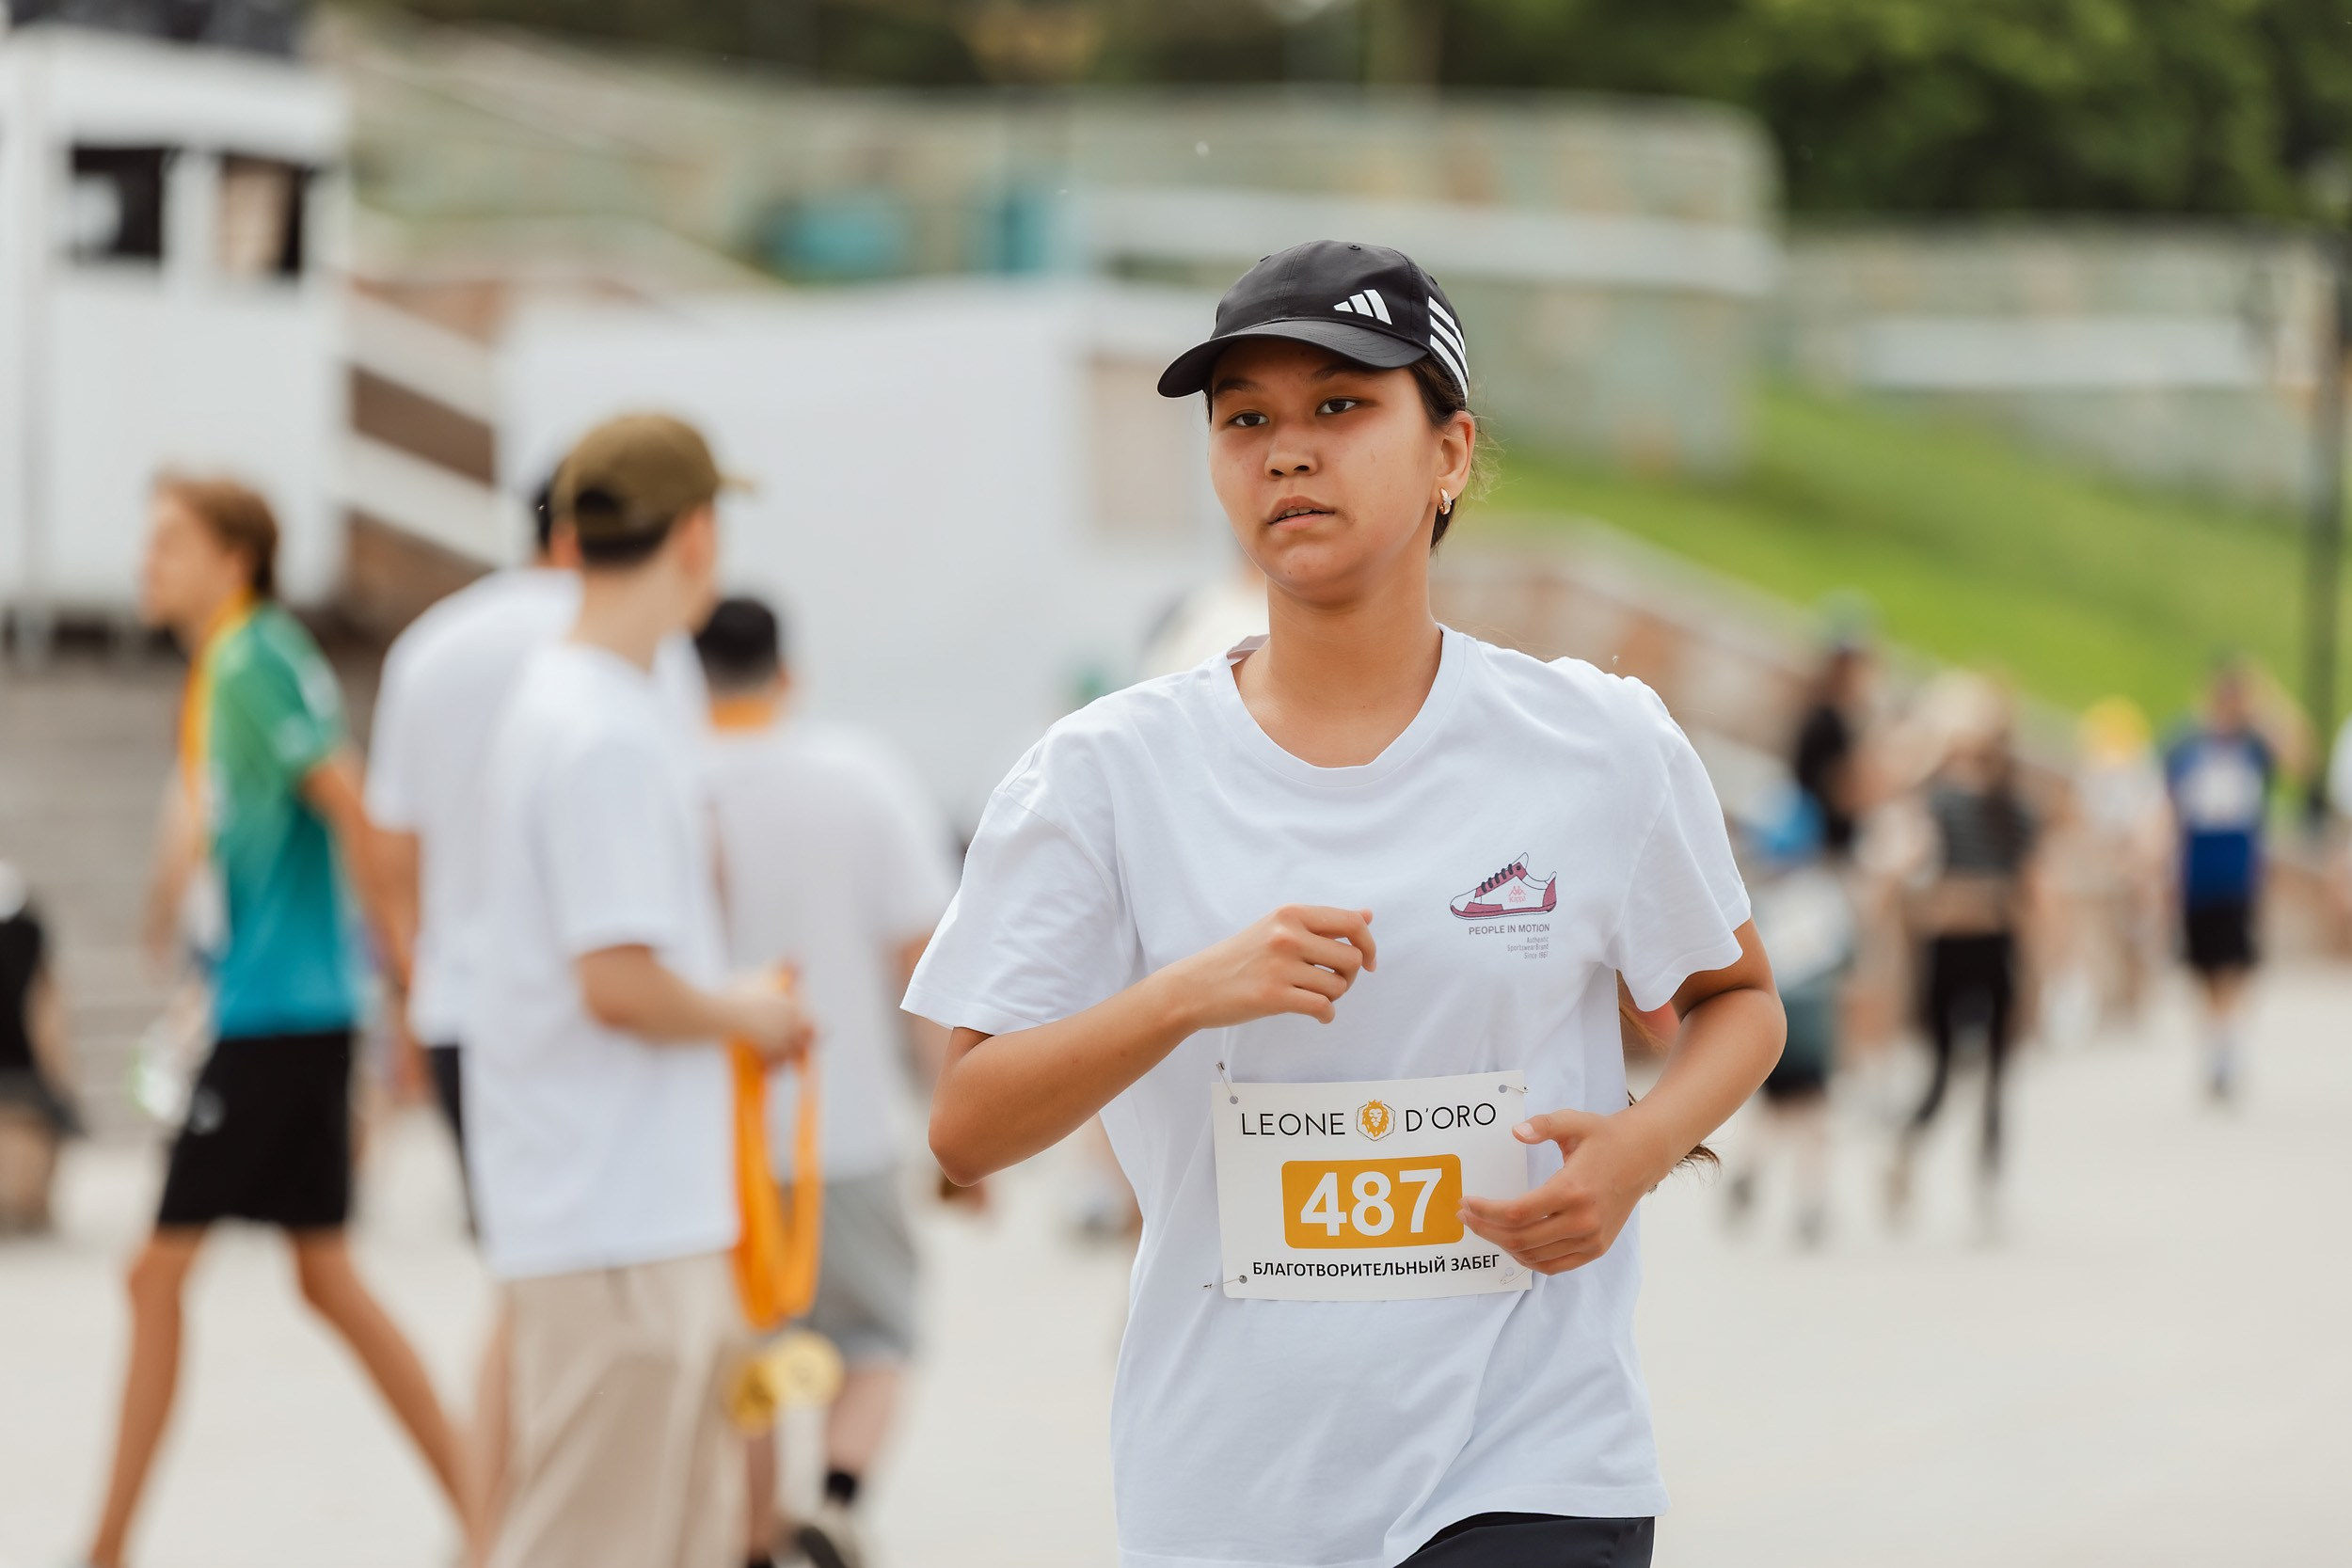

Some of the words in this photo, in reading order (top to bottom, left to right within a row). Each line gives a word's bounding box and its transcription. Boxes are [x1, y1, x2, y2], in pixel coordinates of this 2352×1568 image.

[1469, 926, 1505, 935] PEOPLE
[1507, 925, 1517, 933] IN
[1518, 924, 1550, 933] MOTION
[1241, 1113, 1346, 1136] LEONE
[1406, 1102, 1497, 1132] D'ORO
[1300, 1167, 1443, 1237] 487
[1252, 1256, 1446, 1277] БЛАГОТВОРИТЕЛЬНЫЙ
[1450, 1254, 1501, 1272] ЗАБЕГ
